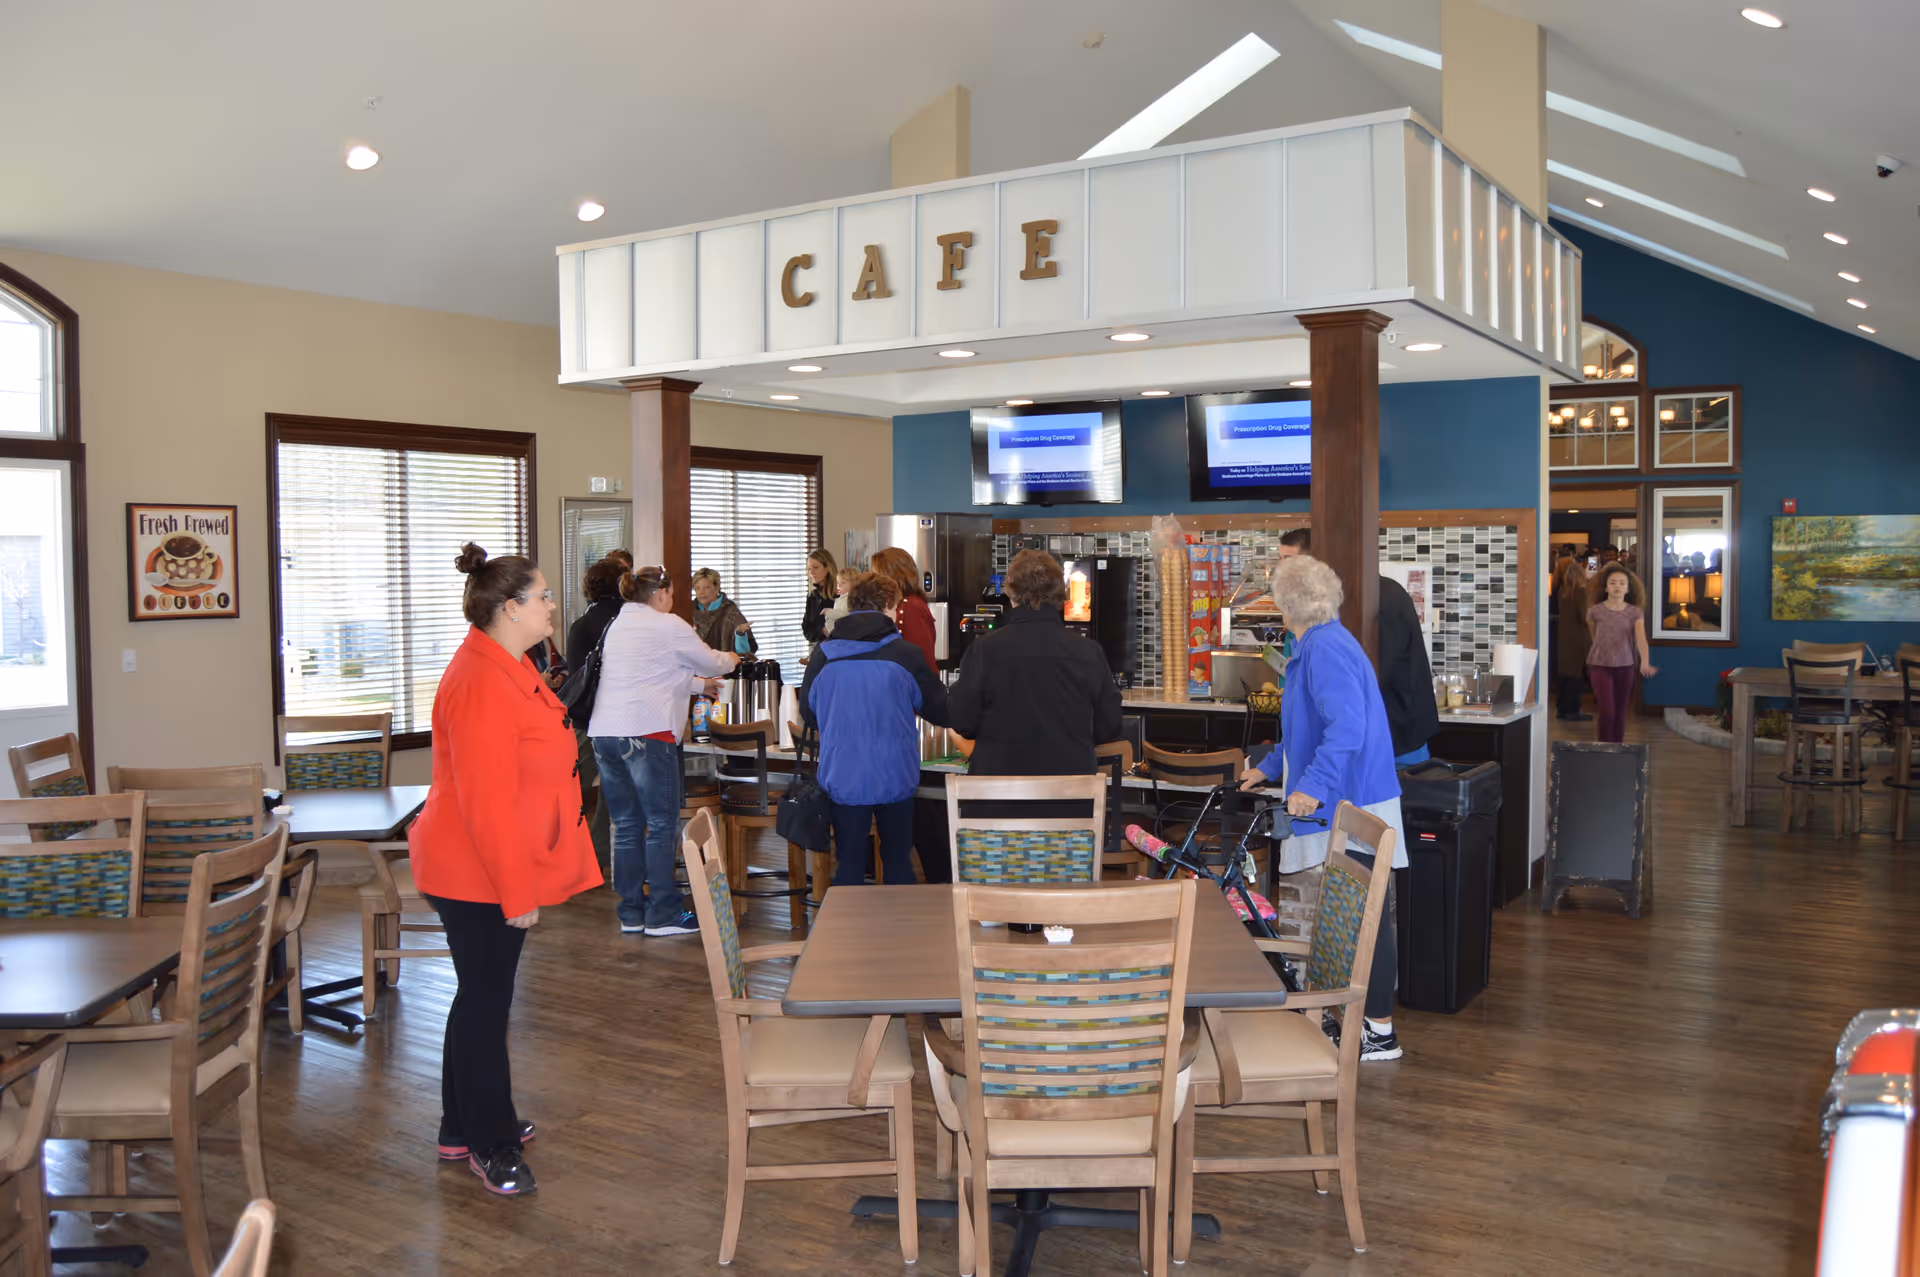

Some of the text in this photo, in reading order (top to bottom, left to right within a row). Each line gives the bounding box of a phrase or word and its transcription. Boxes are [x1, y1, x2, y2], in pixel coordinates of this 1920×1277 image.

[781, 219, 1058, 308] CAFE
[139, 514, 229, 536] Fresh Brewed
